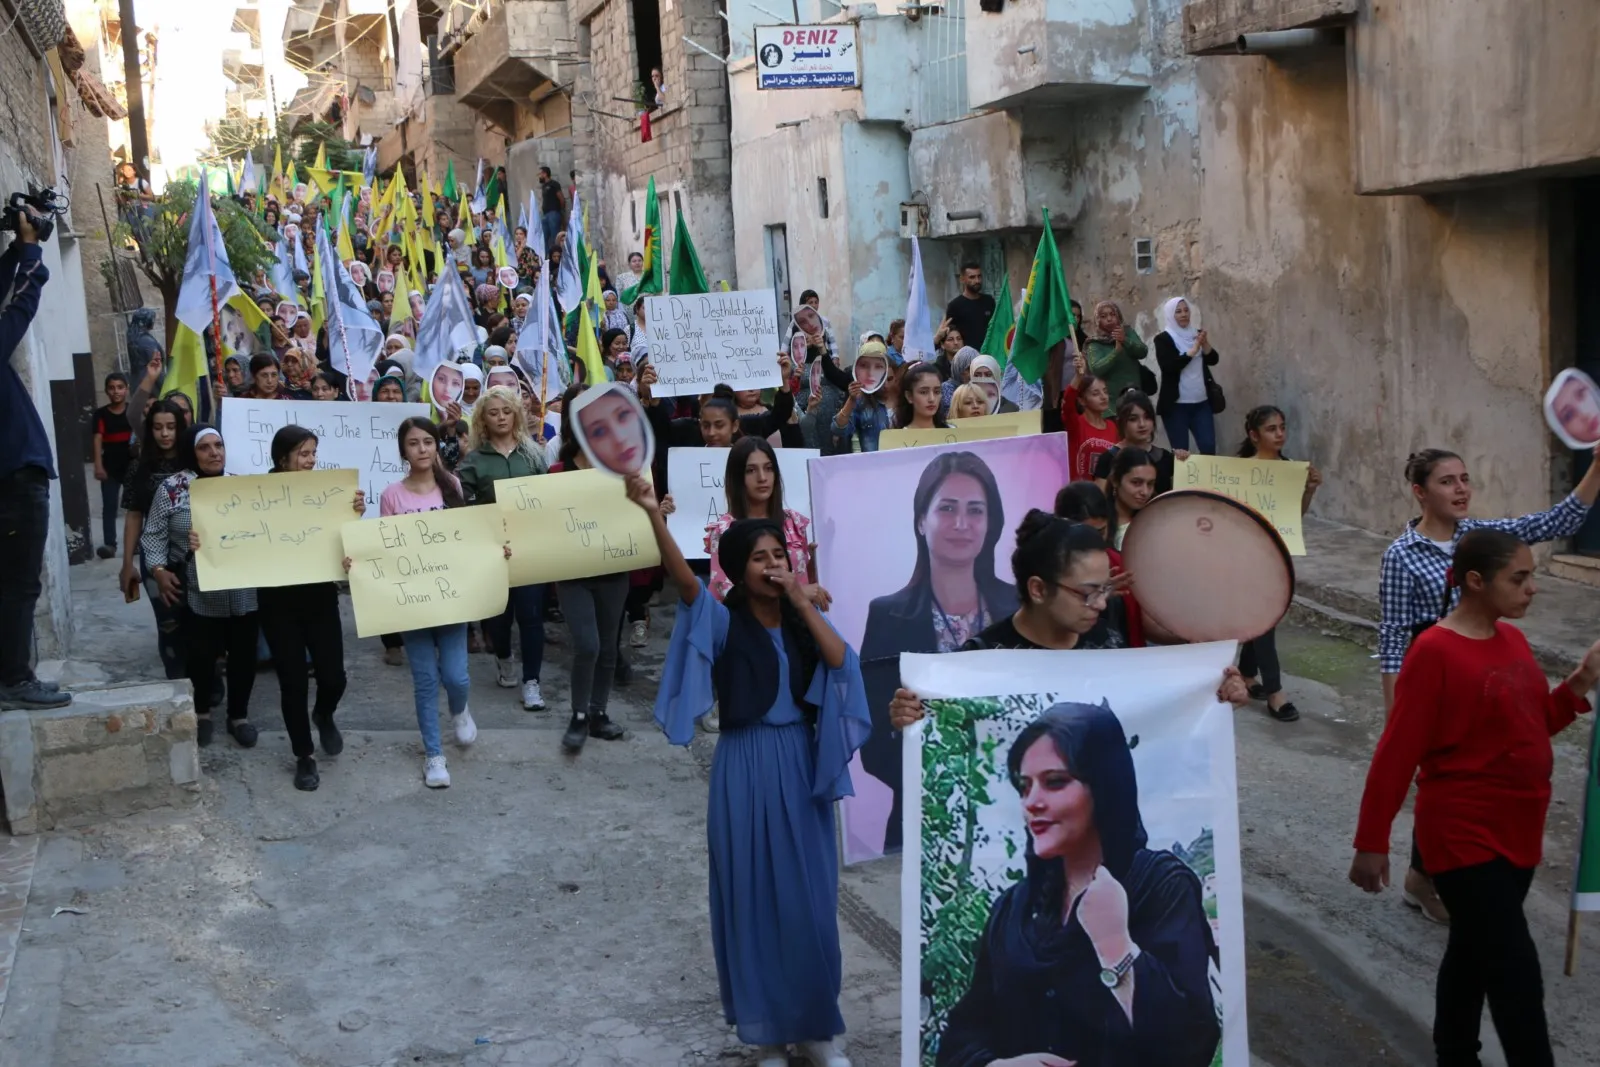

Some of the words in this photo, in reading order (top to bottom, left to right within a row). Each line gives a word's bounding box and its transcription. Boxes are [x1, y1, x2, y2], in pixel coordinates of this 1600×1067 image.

[782, 29, 838, 46] DENIZ
[790, 46, 832, 62] دنيز
[789, 75, 808, 85] تجهيز
[812, 74, 837, 84] تعليمية
[837, 73, 854, 83] دورات
[650, 298, 663, 321] Li
[652, 325, 671, 341] Wê
[651, 344, 678, 364] Bibe
[247, 409, 274, 434] Em
[1186, 461, 1200, 484] Bi
[215, 493, 242, 516] هي
[251, 484, 292, 512] المرأة
[302, 486, 344, 509] حرية
[507, 483, 543, 511] Jin
[279, 525, 322, 545] حرية
[378, 520, 407, 549] Êdî
[414, 519, 447, 545] Bes
[453, 529, 463, 541] e
[559, 507, 599, 547] Jiyan
[602, 532, 638, 561] Azadi
[366, 557, 386, 580] Ji
[392, 582, 432, 606] Jinan
[435, 576, 461, 600] Re
